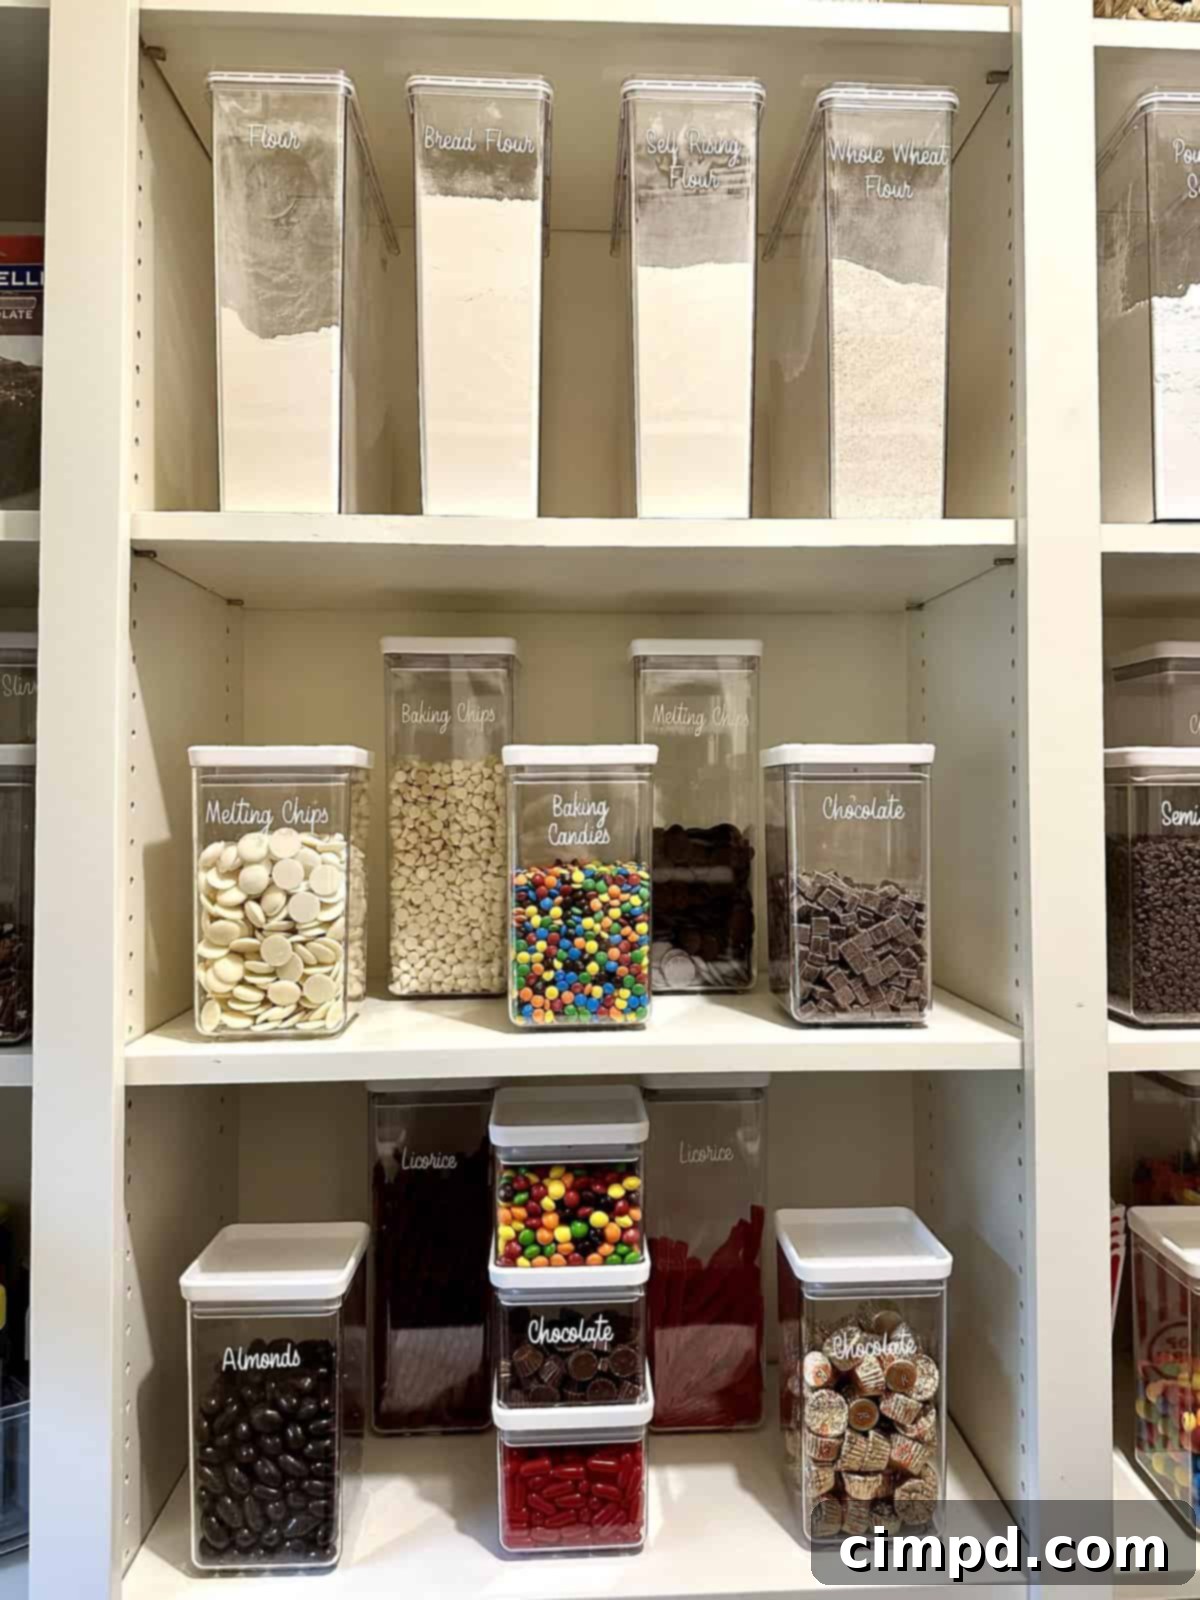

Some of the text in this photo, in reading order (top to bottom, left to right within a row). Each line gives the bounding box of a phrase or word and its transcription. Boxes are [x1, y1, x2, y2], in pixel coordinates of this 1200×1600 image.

[247, 123, 301, 149] Flour
[424, 125, 535, 153] Bread Flour
[646, 128, 741, 168] Self Rising
[828, 138, 951, 165] Whole Wheat
[670, 164, 720, 189] Flour
[865, 175, 913, 199] Flour
[0, 310, 33, 320] LATE
[402, 700, 495, 734] Baking Chips
[652, 702, 705, 737] Melting
[205, 796, 329, 836] Melting Chips
[552, 790, 610, 829] Baking
[822, 793, 906, 820] Chocolate
[548, 822, 611, 846] Candies
[402, 1144, 458, 1170] Licorice
[680, 1140, 734, 1164] Licorice
[528, 1313, 614, 1345] Chocolate
[833, 1325, 918, 1360] Chocolate
[222, 1342, 301, 1372] Almonds
